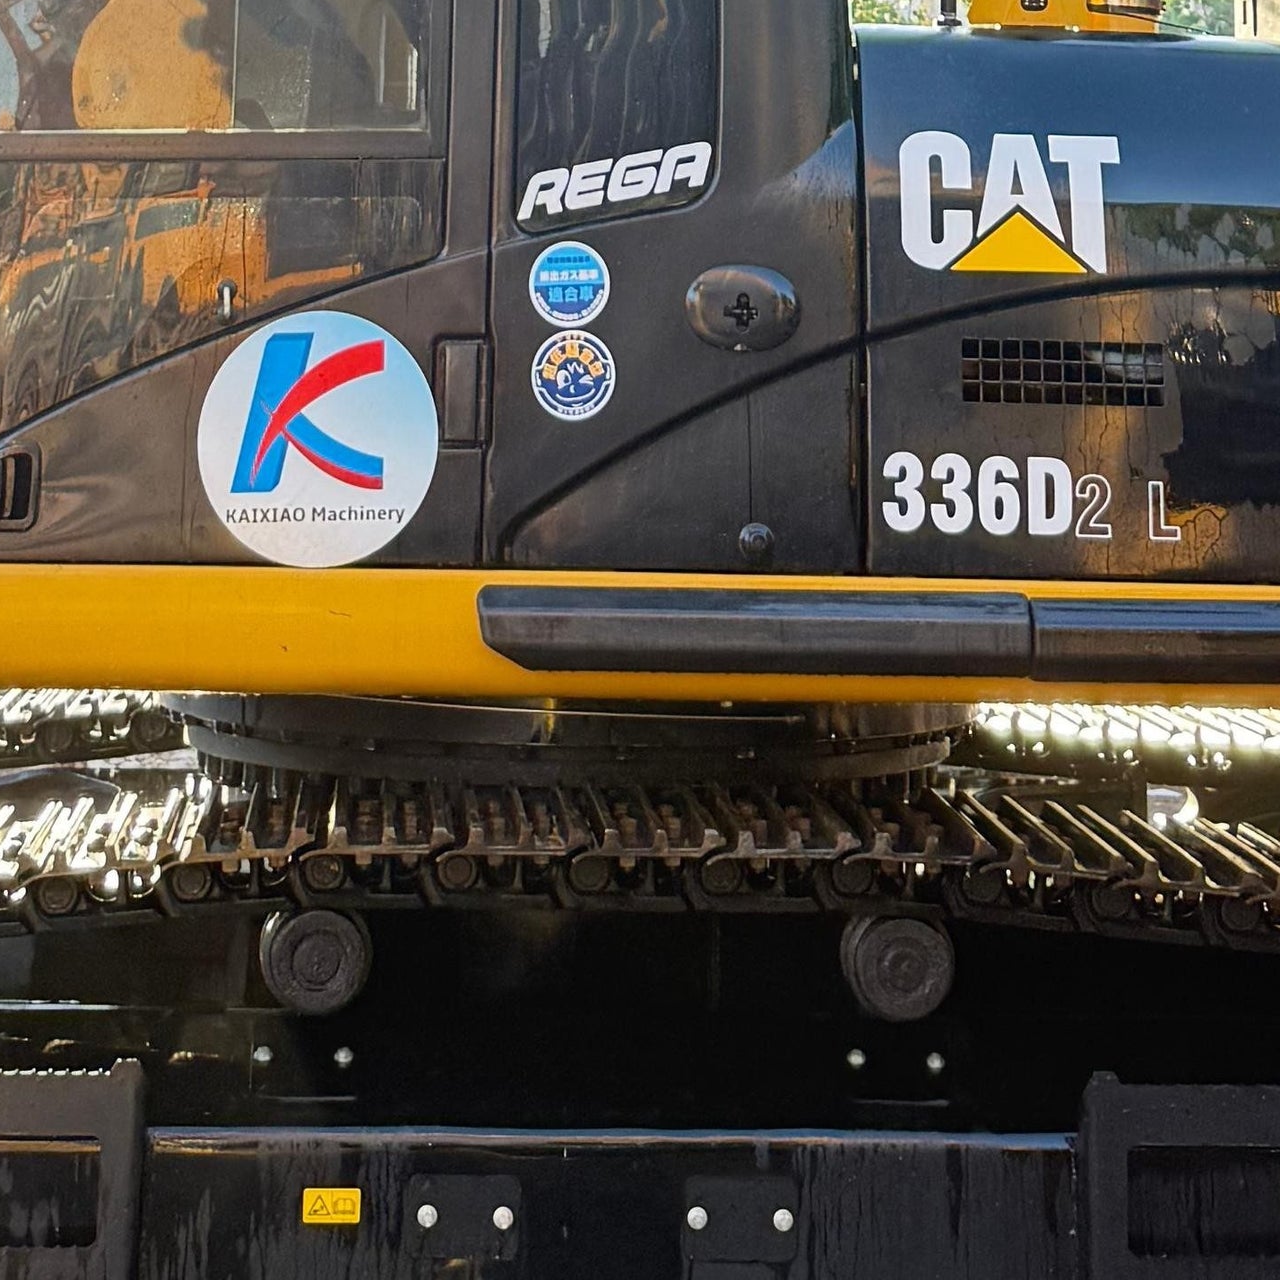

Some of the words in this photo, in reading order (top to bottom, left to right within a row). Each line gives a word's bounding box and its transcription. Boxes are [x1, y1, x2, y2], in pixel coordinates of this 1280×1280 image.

[517, 141, 712, 220] REGA
[899, 131, 1121, 275] CAT
[226, 507, 306, 524] KAIXIAO
[312, 505, 405, 524] Machinery
[1147, 481, 1181, 541] L
